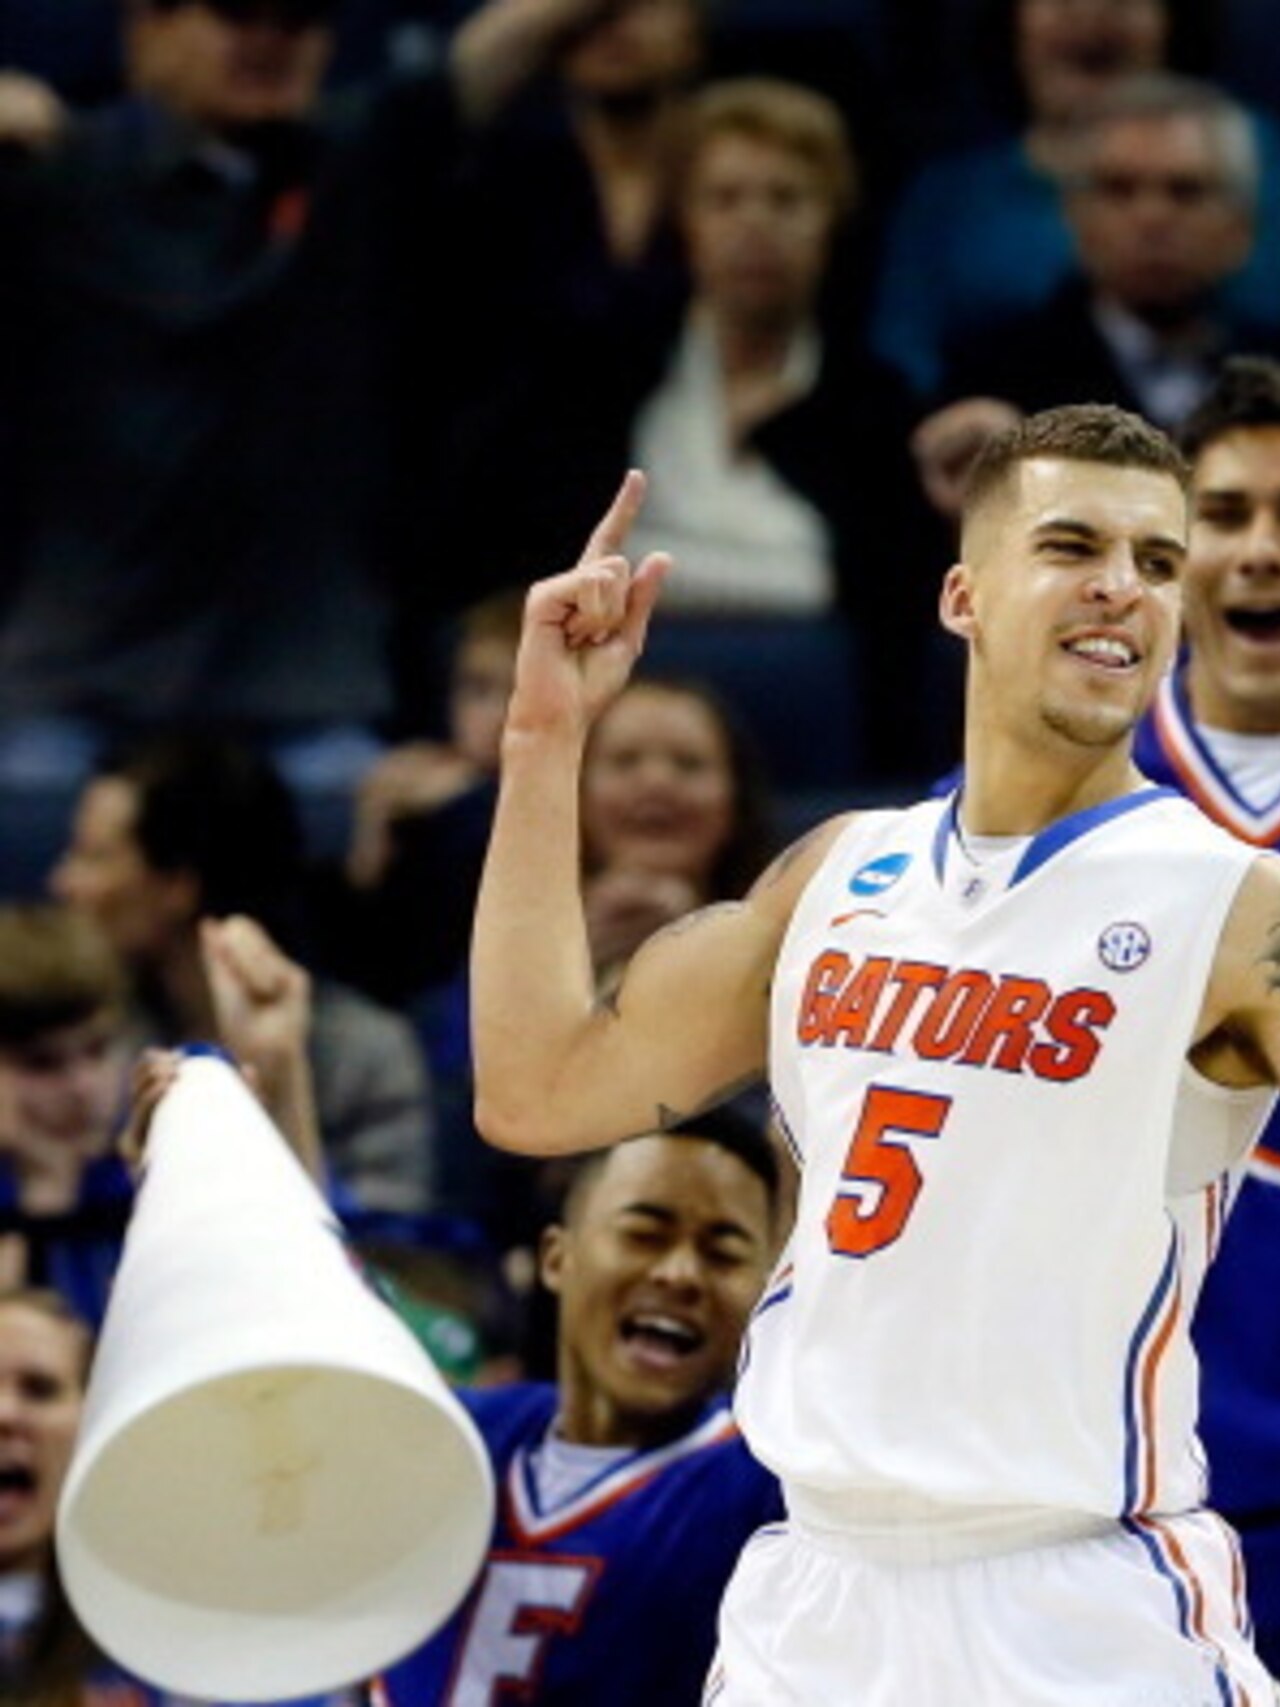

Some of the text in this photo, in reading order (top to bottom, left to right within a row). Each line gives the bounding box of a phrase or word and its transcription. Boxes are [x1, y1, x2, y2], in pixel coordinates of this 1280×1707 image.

[797, 948, 1117, 1083] GATORS
[825, 1083, 953, 1260] 5
[443, 1547, 605, 1706] F
